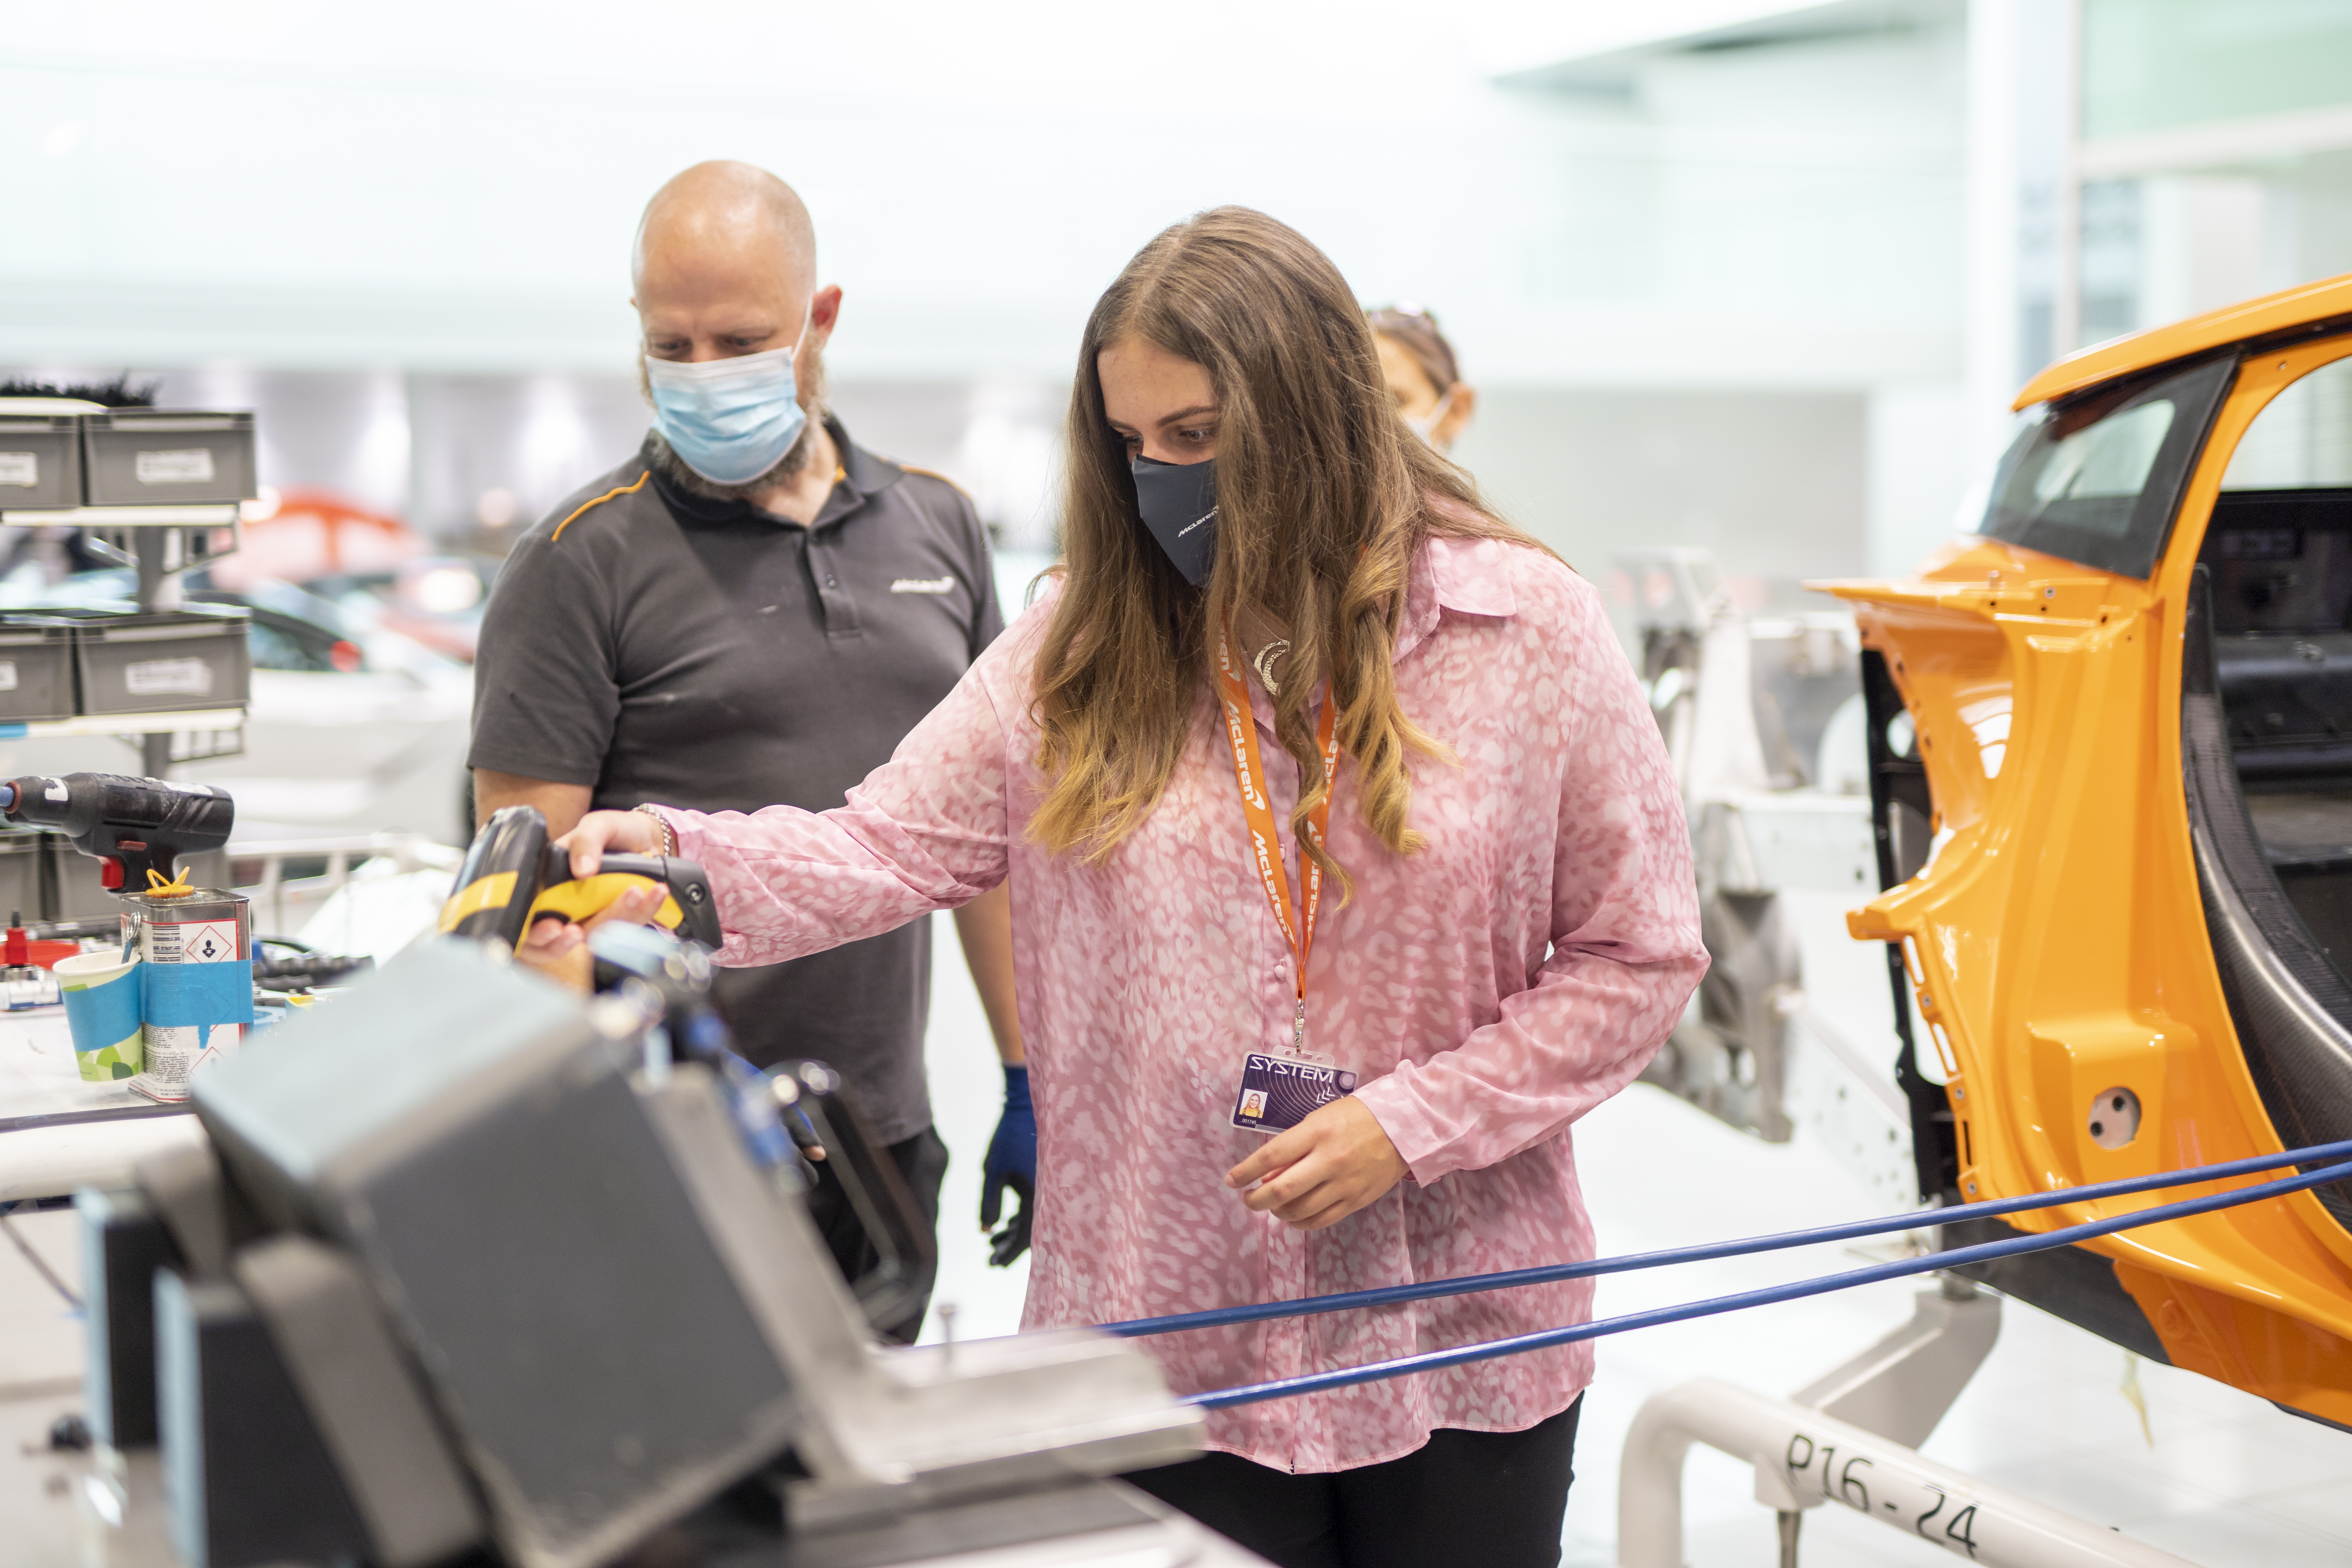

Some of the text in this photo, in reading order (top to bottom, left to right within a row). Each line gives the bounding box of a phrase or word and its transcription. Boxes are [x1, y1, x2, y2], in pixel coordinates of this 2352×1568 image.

[1227, 699, 1254, 800] McLaren
[1252, 829, 1287, 932] McLaren
[1249, 1056, 1334, 1083] SYSTEM
